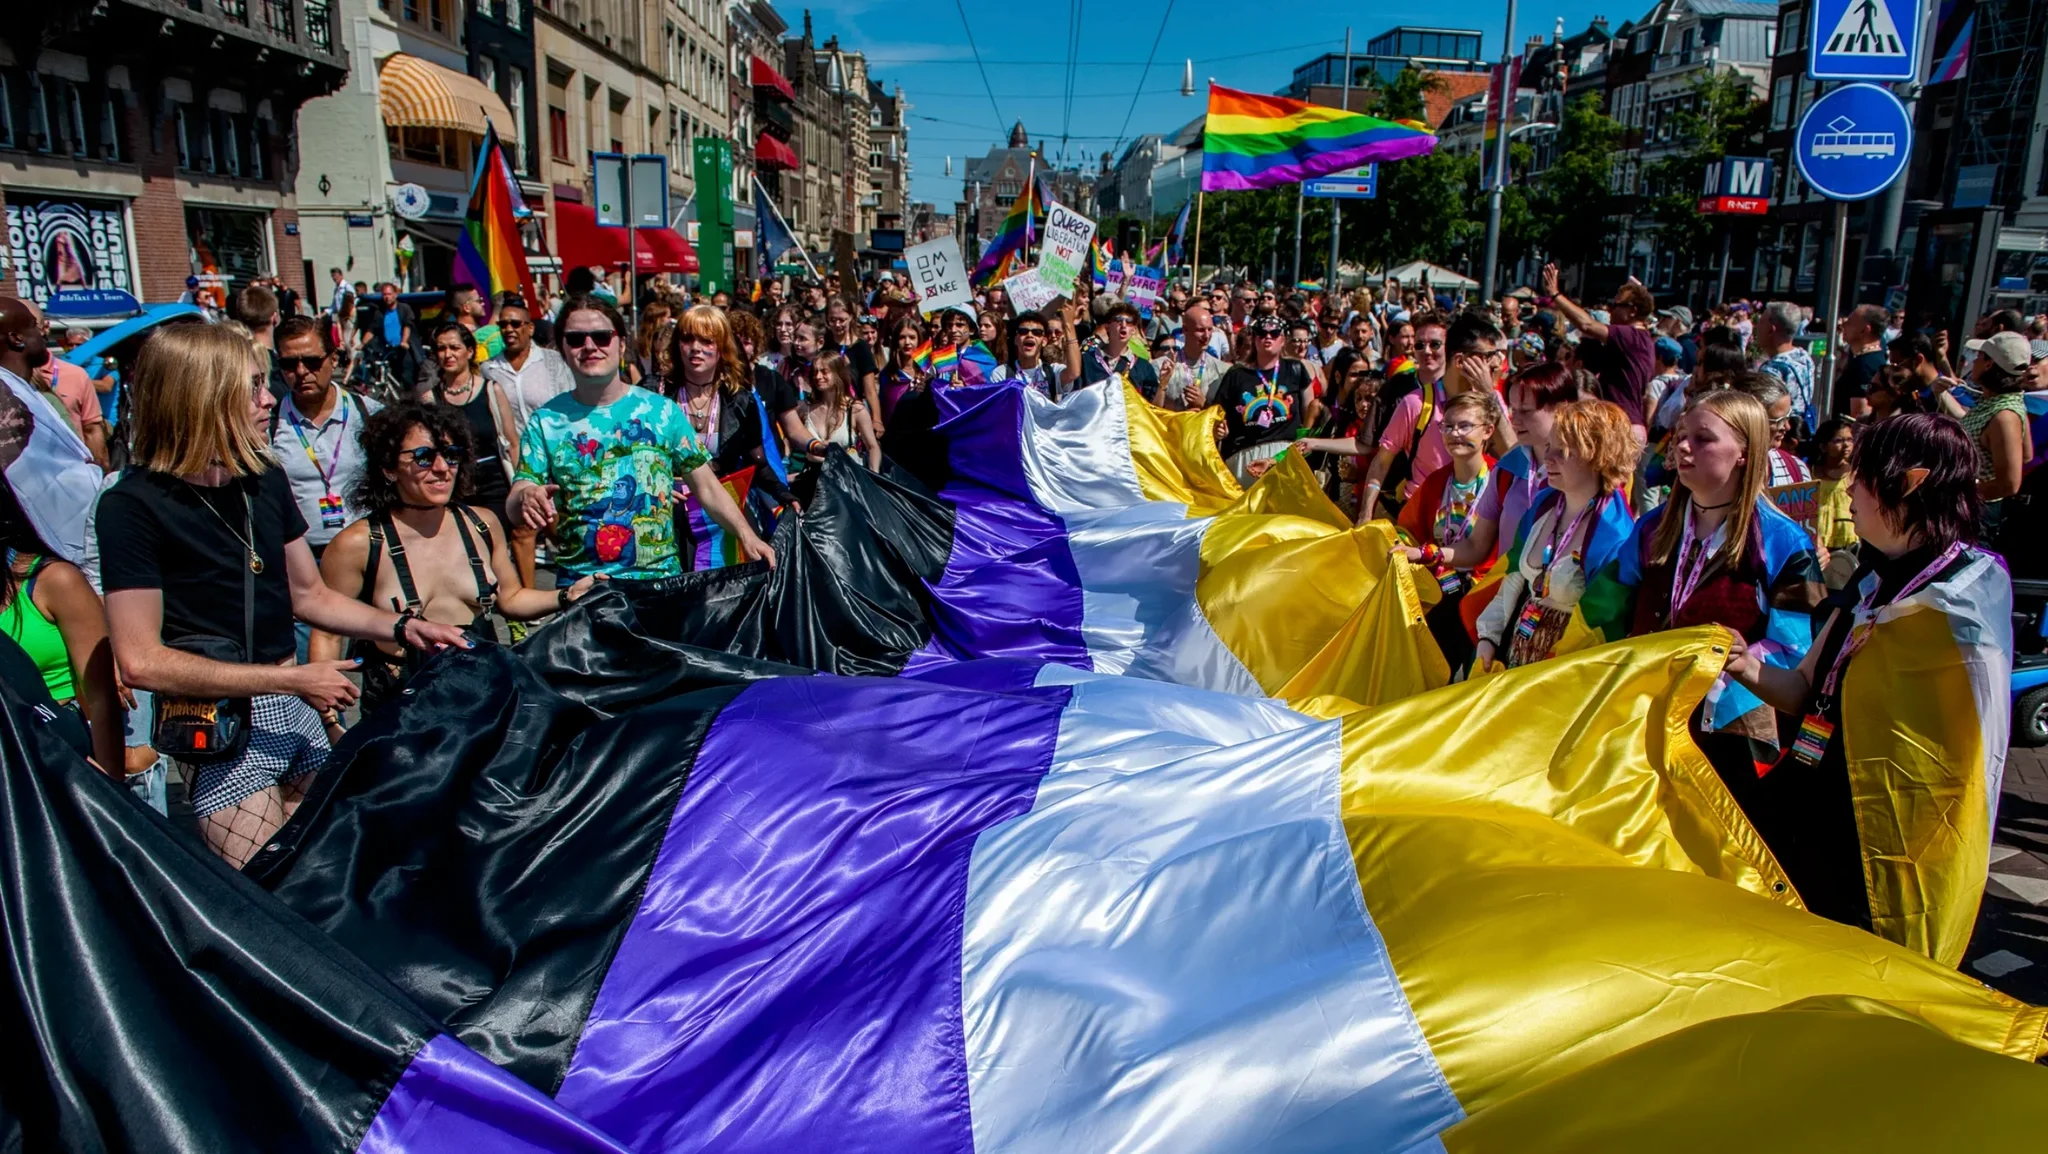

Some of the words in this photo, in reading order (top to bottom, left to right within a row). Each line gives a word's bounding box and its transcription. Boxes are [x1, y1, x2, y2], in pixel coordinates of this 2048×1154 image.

[1704, 162, 1722, 196] M
[1730, 161, 1765, 195] M
[23, 206, 45, 280] GOOD
[89, 210, 114, 290] SHION
[105, 211, 127, 288] SEUM
[1046, 225, 1088, 255] LIBERATION
[6, 205, 32, 299] SHION
[933, 251, 948, 265] M
[1055, 245, 1073, 261] NOT
[936, 266, 945, 277] V
[1020, 270, 1037, 286] PRID
[1109, 274, 1156, 291] TRASFAG
[939, 280, 958, 294] NEE
[1011, 287, 1031, 303] PART
[162, 700, 218, 723] THRASHER
